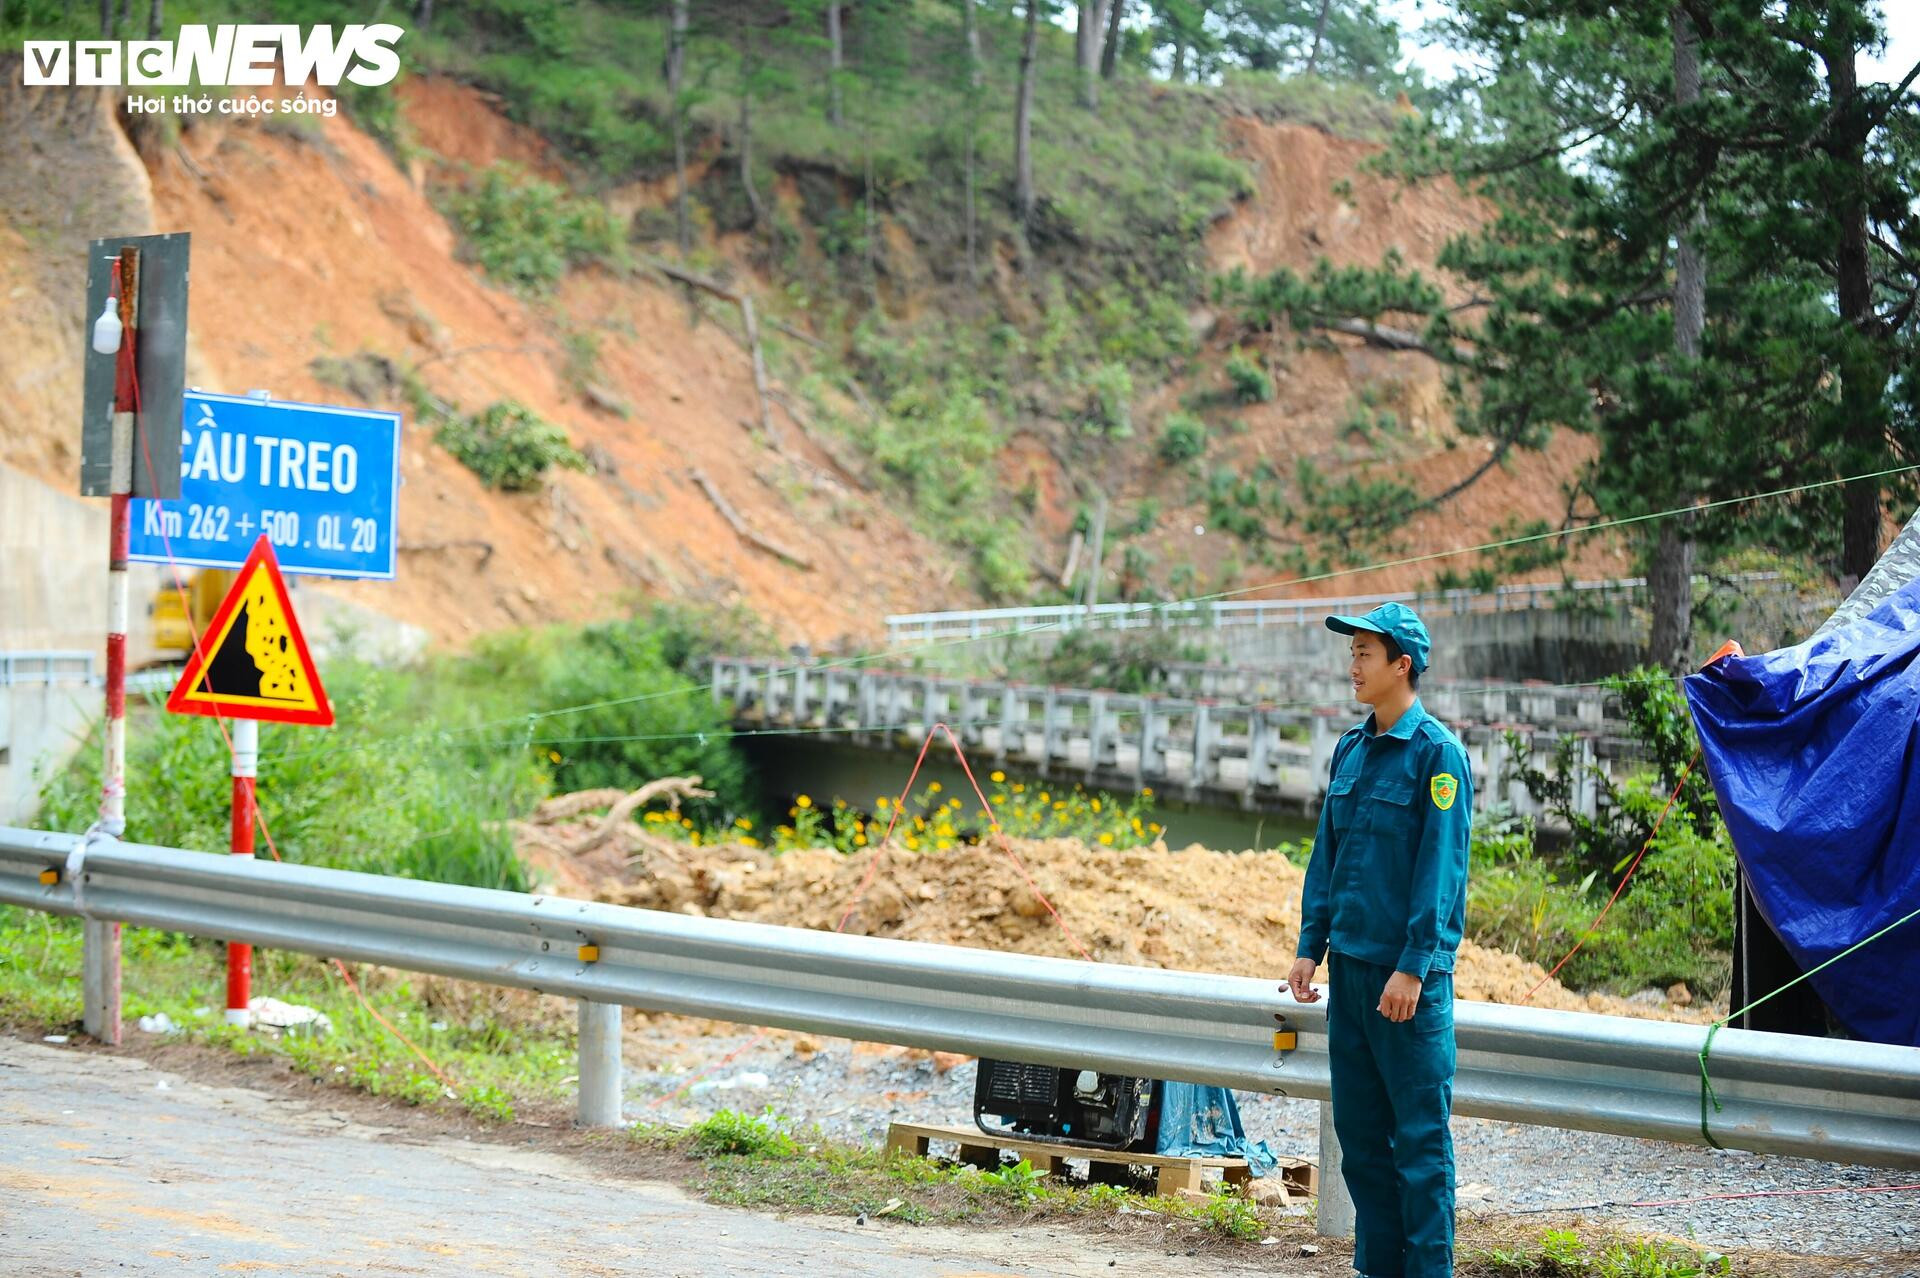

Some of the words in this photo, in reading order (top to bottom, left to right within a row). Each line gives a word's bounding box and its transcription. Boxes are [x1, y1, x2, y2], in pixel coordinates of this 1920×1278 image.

[253, 435, 358, 494] TREO
[144, 500, 182, 538] Km
[188, 504, 230, 542] 262
[261, 509, 299, 548] 500
[317, 515, 346, 551] QL
[351, 517, 378, 553] 20
